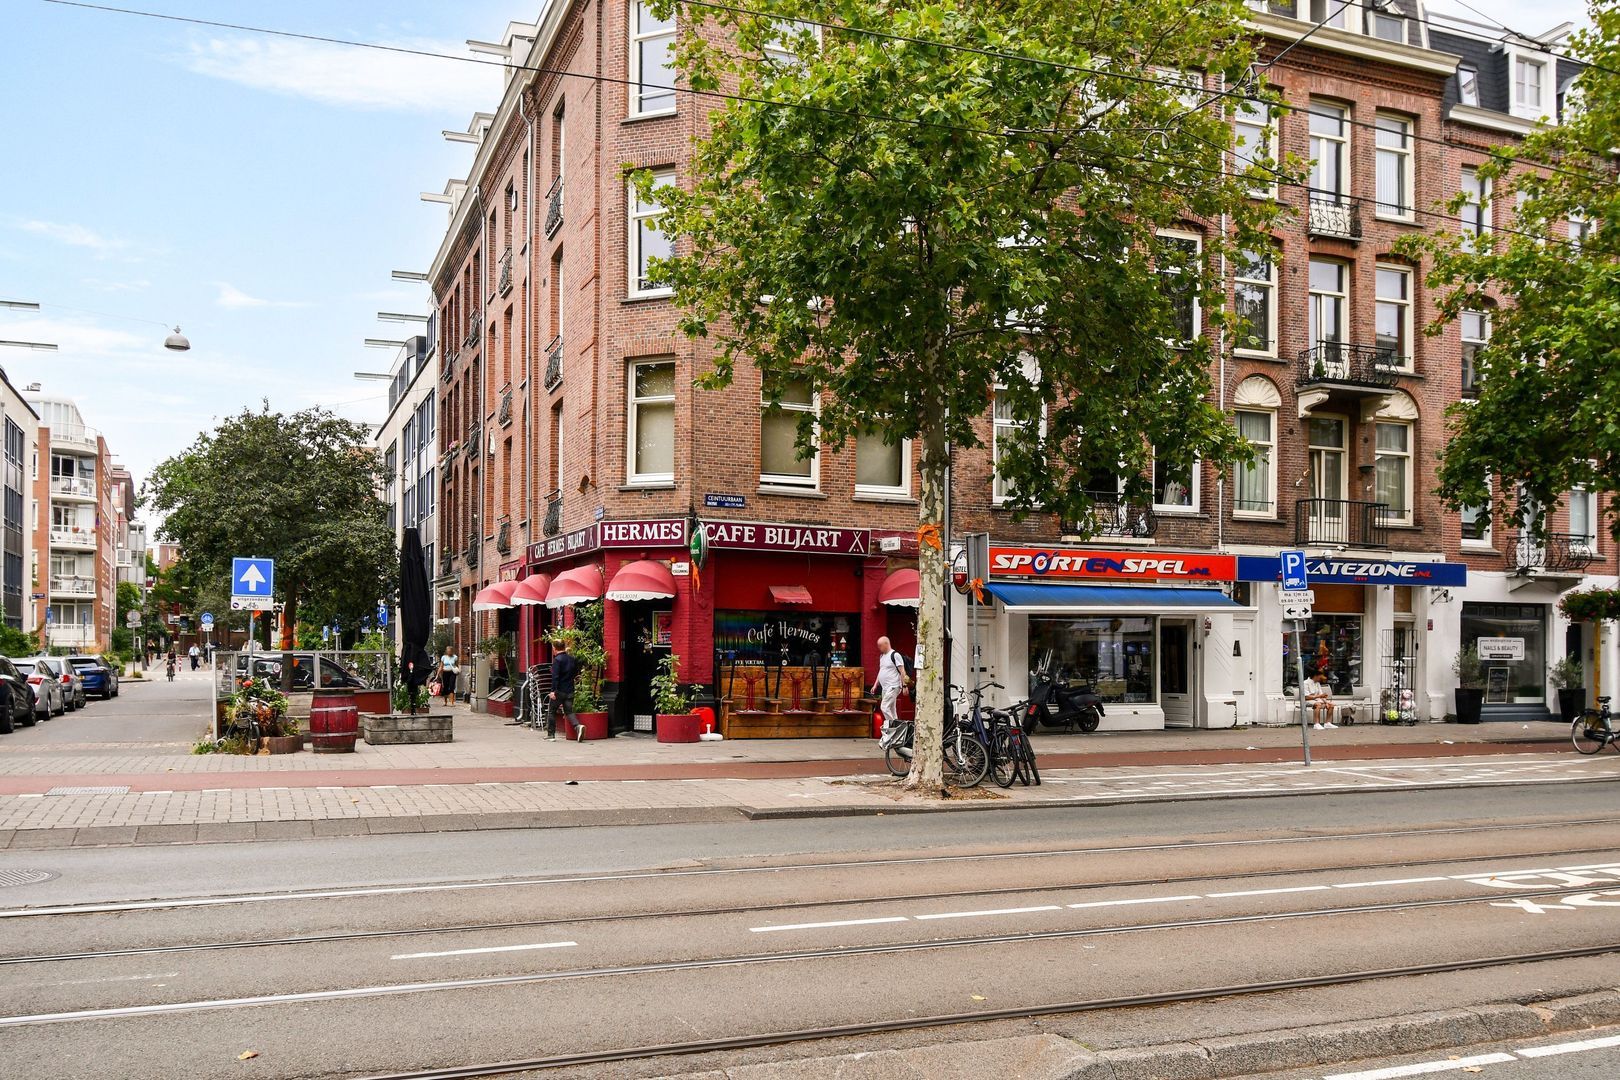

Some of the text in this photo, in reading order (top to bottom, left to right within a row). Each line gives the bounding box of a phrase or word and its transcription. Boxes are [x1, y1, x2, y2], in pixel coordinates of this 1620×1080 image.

[603, 522, 682, 541] HERMES
[704, 523, 842, 550] CAFE BILJART
[534, 532, 585, 559] CAFE HERMES BILJART
[1287, 554, 1300, 574] P
[747, 621, 820, 644] Café Hermes
